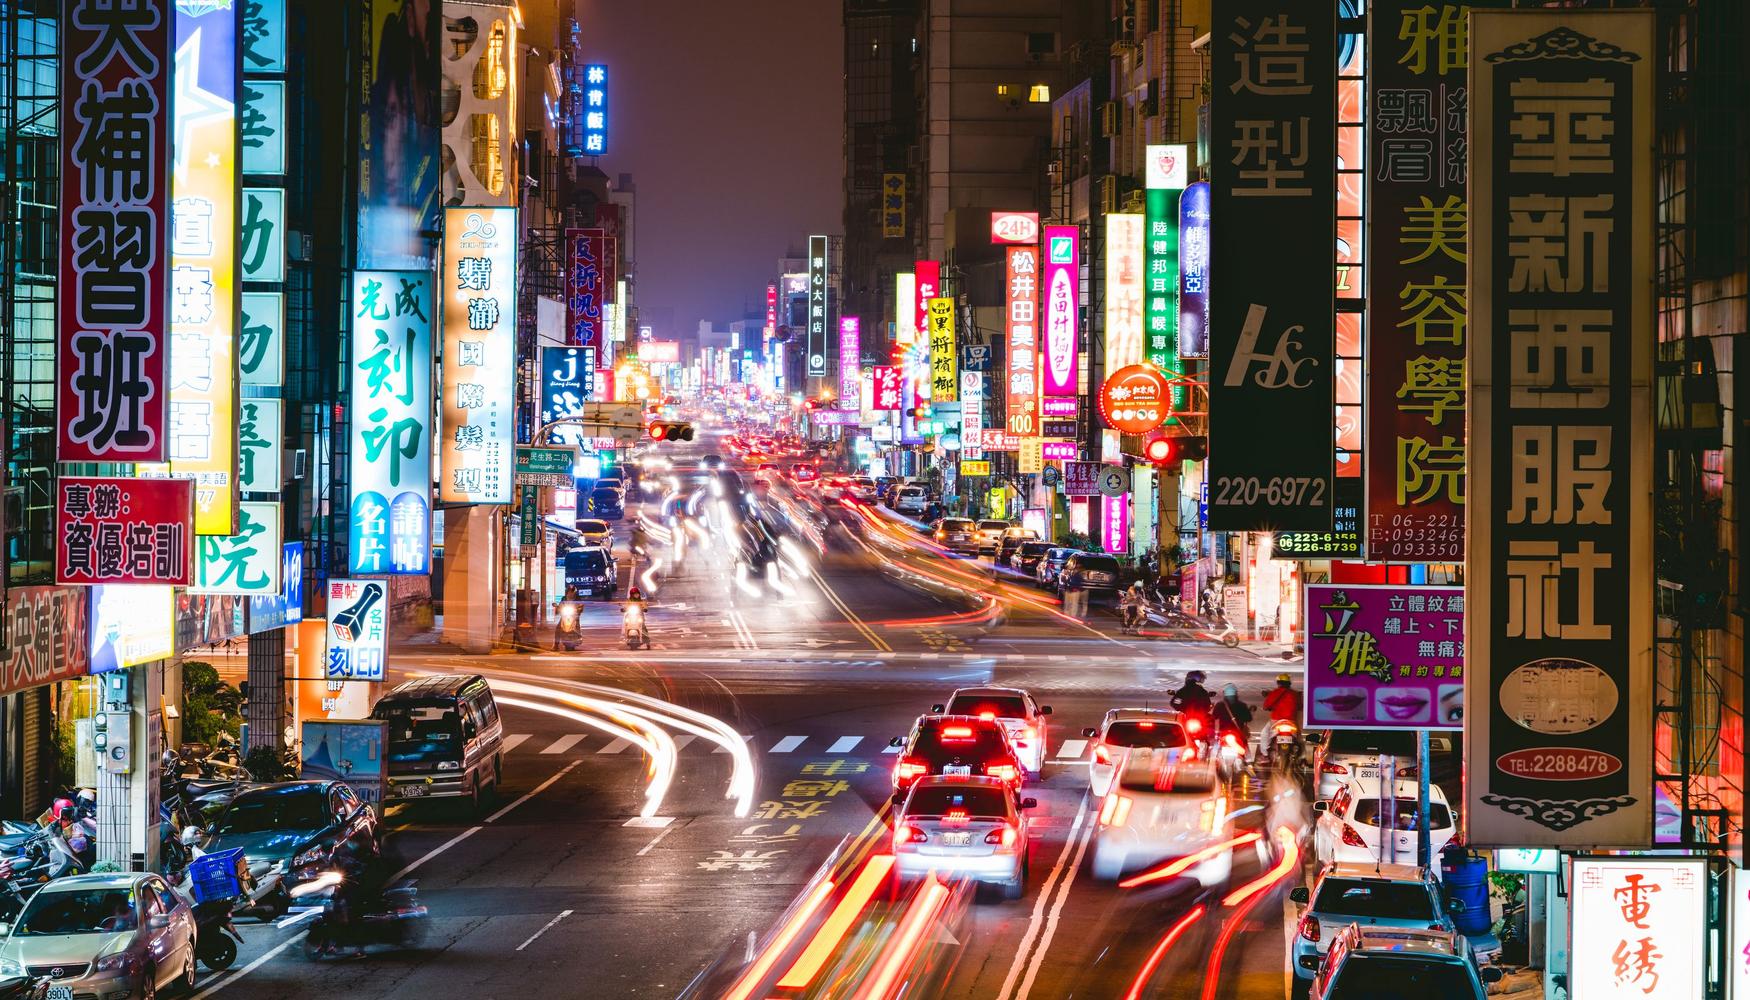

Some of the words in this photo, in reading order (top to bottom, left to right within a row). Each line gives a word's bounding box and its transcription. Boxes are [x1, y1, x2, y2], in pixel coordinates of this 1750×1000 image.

[588, 67, 604, 150] 林肯飯店
[1228, 14, 1314, 196] 造型
[1377, 88, 1437, 183] 飄眉
[1000, 220, 1031, 236] 24H
[813, 257, 824, 333] 華心大飯店
[1011, 251, 1035, 395] 松井田臭臭鍋
[932, 317, 953, 393] 黑將檳榔
[1396, 195, 1467, 507] 美容學院
[1507, 78, 1615, 640] 華新西服社
[358, 329, 423, 487] 刻印
[964, 402, 979, 458] 三陽機車
[530, 452, 568, 462] 民生路二段
[1215, 476, 1327, 507] 220-6972
[355, 501, 386, 570] 名片
[393, 502, 423, 571] 請帖
[1294, 543, 1357, 552] 226-8739
[1393, 514, 1465, 527] 06-221
[1393, 529, 1465, 541] 093246
[64, 520, 184, 578] 資優培訓
[1392, 543, 1465, 555] 093350
[331, 583, 358, 599] 喜帖
[1389, 595, 1464, 612] 立體紋繡
[369, 608, 382, 640] 名片
[1384, 618, 1464, 635] 繡上、下
[329, 645, 381, 677] 刻印
[1510, 755, 1608, 773] TEL:2288478
[1611, 874, 1664, 994] 電繡
